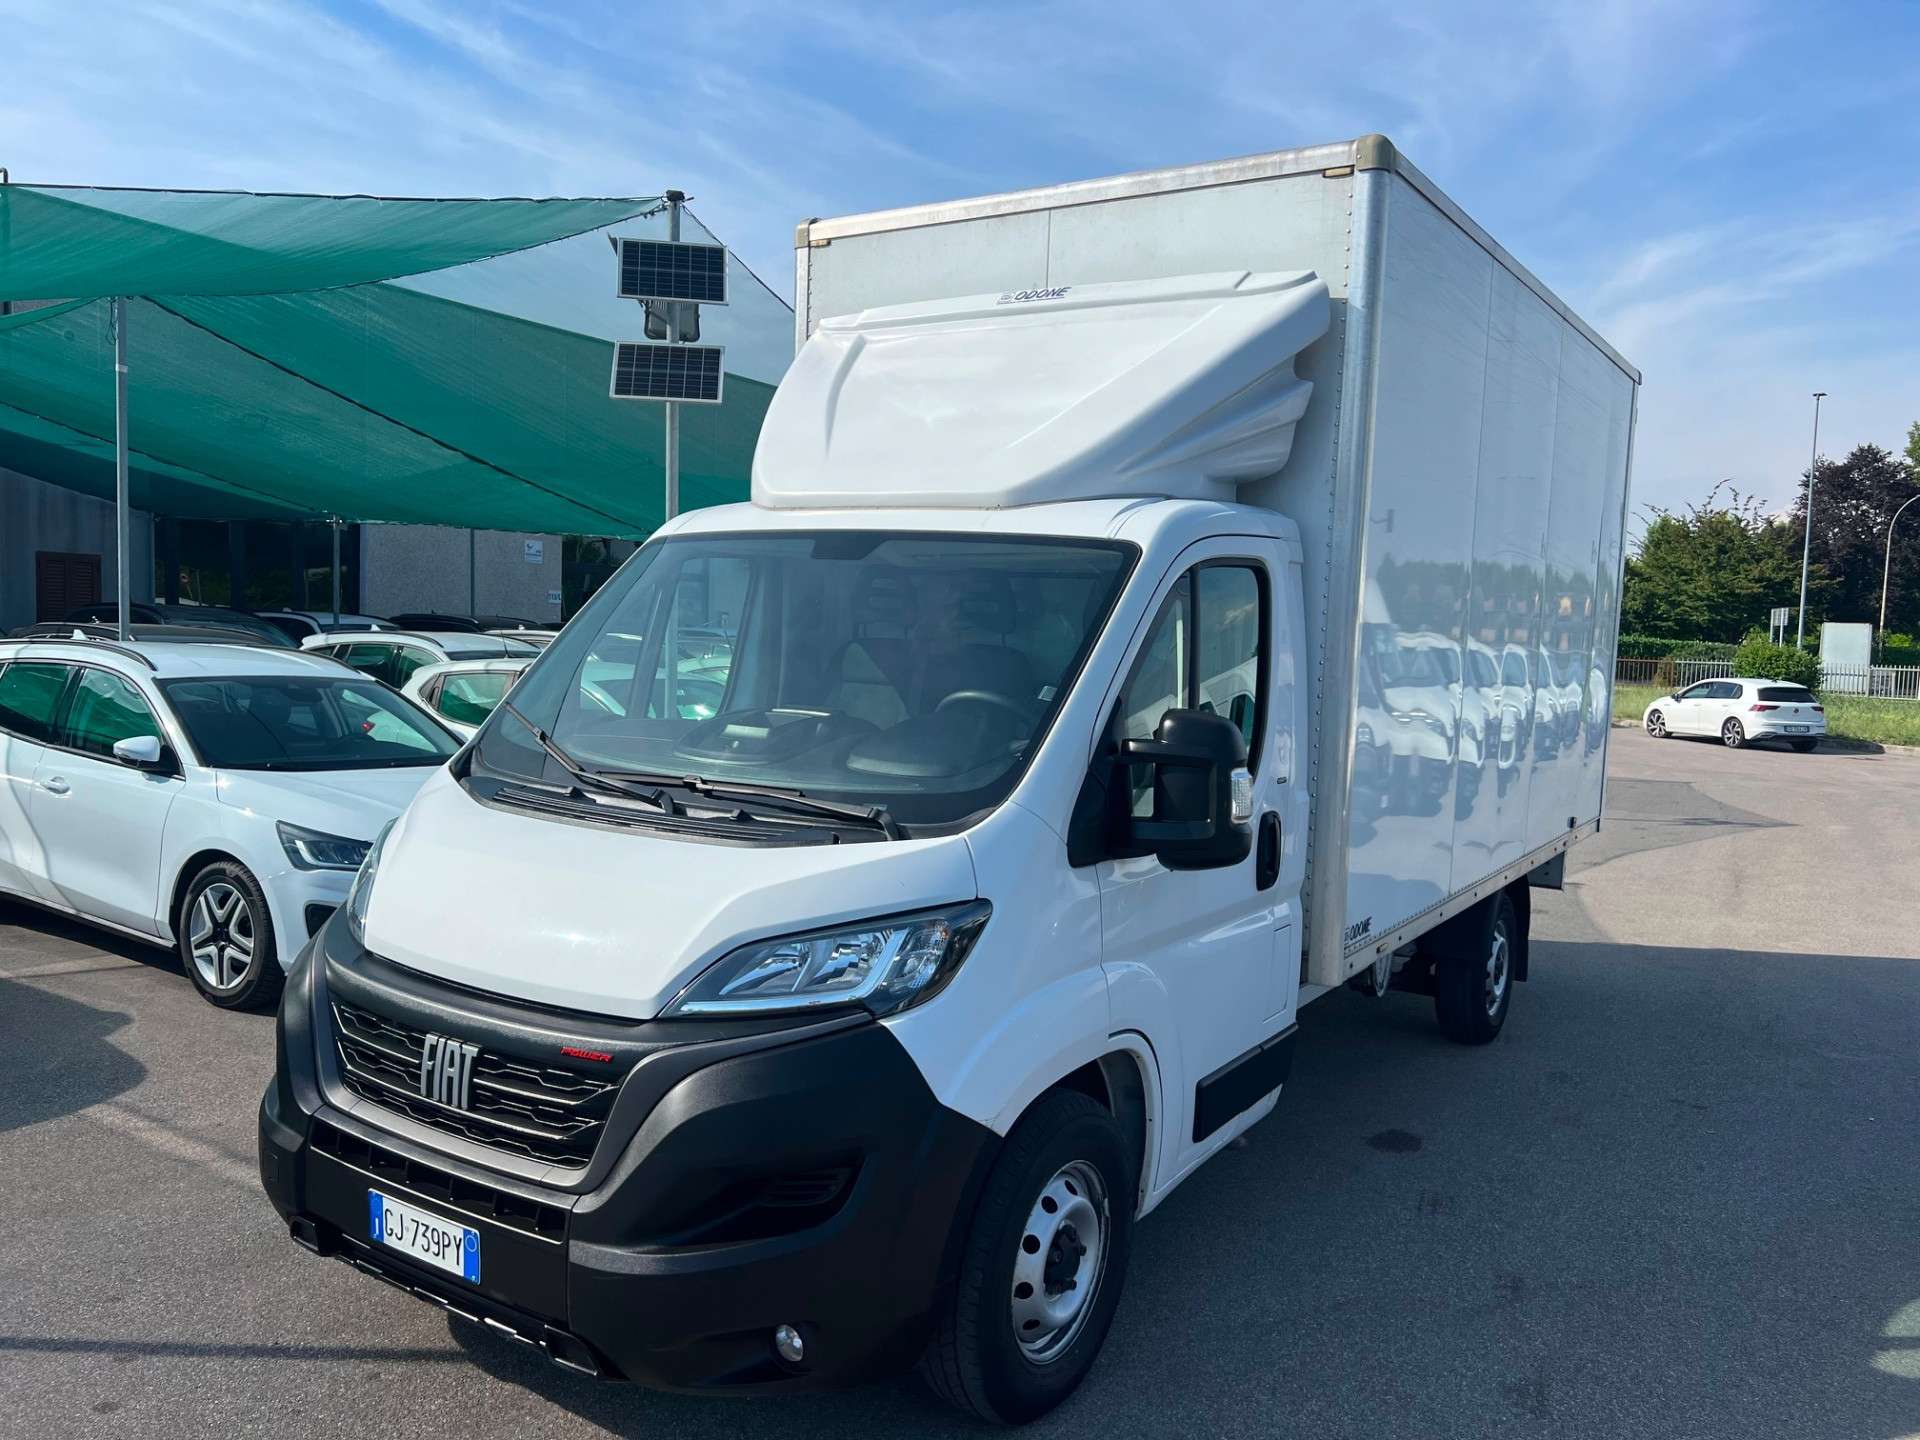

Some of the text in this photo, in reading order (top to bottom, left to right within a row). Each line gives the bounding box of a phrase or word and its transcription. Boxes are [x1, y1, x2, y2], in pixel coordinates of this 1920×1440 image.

[1014, 286, 1072, 301] ODONE
[420, 1032, 479, 1110] FIAT
[560, 1046, 614, 1063] POWER
[384, 1208, 404, 1241] GJ
[410, 1218, 462, 1266] 739PY
